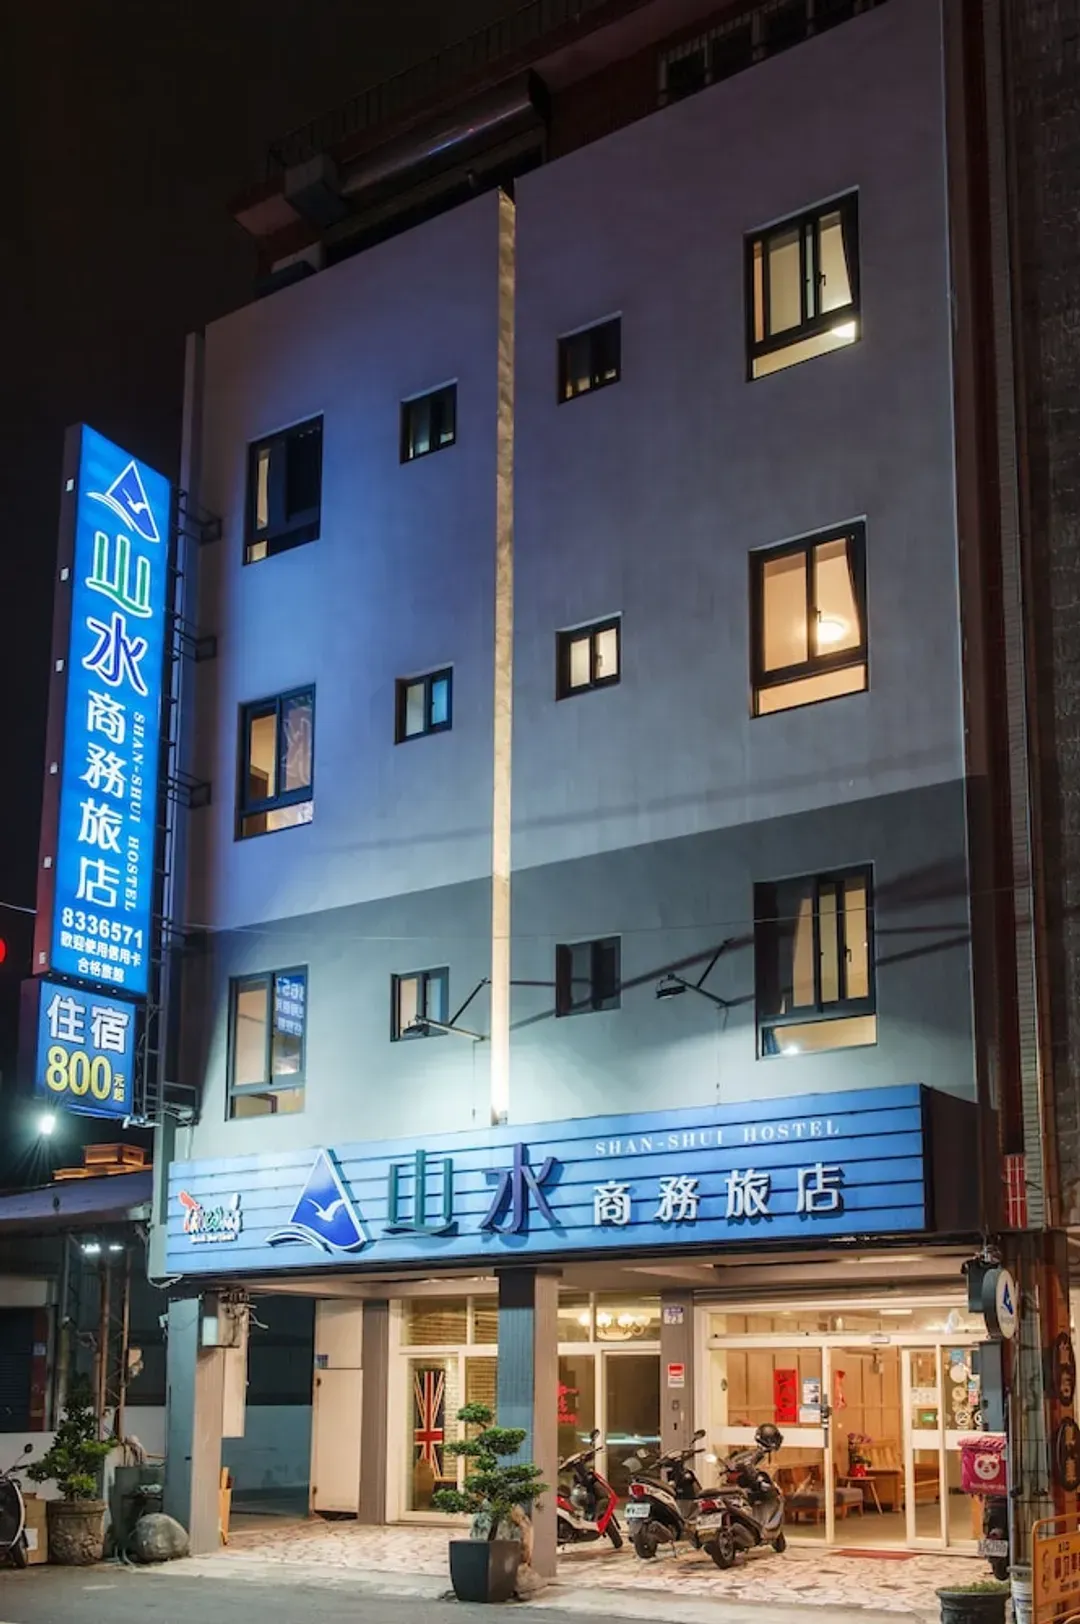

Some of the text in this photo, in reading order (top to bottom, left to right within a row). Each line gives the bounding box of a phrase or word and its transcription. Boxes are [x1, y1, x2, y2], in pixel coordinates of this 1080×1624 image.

[82, 531, 153, 696] 山水
[75, 689, 127, 908] 商務旅店
[125, 712, 145, 912] SHAN-SHUI HOSTEL
[62, 907, 143, 949] 8336571
[47, 994, 129, 1054] 住宿
[46, 1046, 112, 1100] 800
[596, 1120, 841, 1156] SHAN-SHUI HOSTEL
[383, 1143, 562, 1236] 山水
[594, 1163, 842, 1227] 商務旅店
